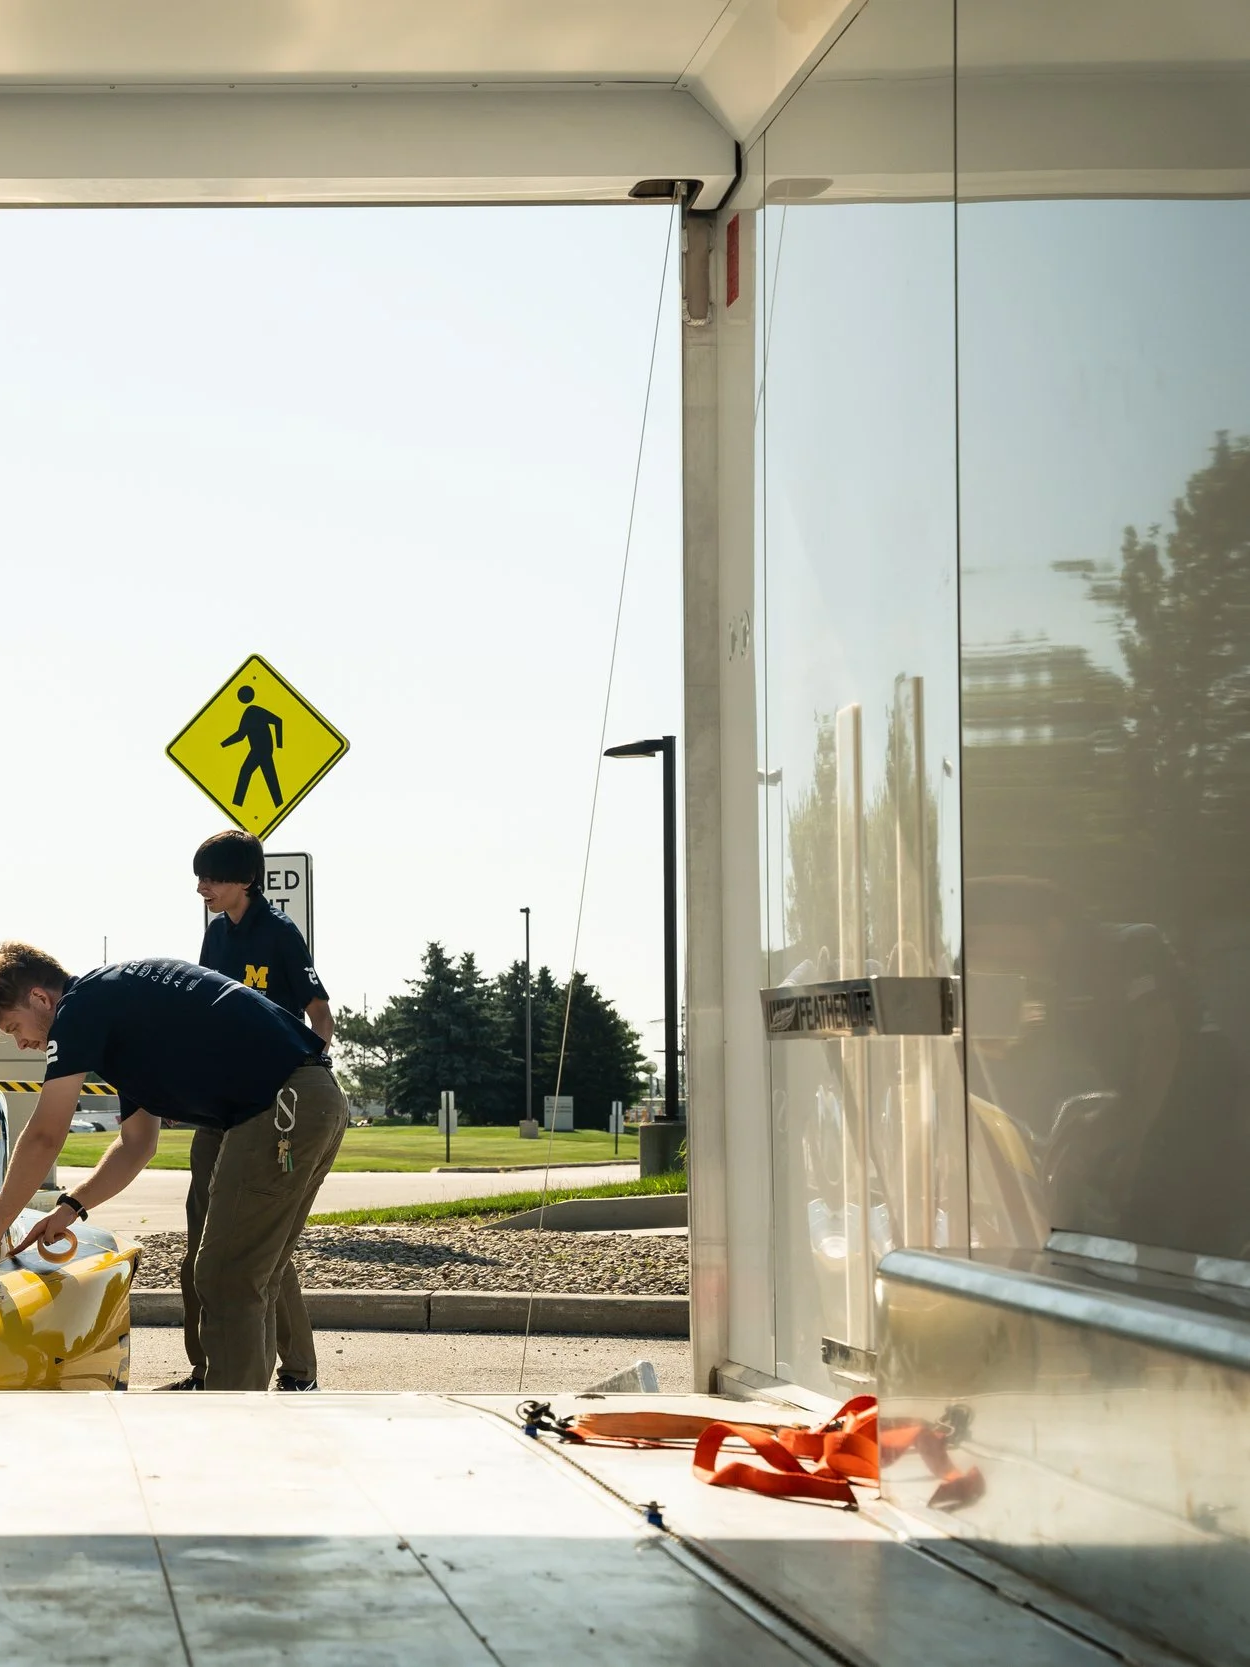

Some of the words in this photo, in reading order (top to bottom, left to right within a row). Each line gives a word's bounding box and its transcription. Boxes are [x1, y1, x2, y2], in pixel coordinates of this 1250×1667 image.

[267, 870, 300, 890] ED
[244, 965, 269, 988] M
[797, 989, 873, 1031] FEATHERLITE
[46, 1040, 58, 1064] 2
